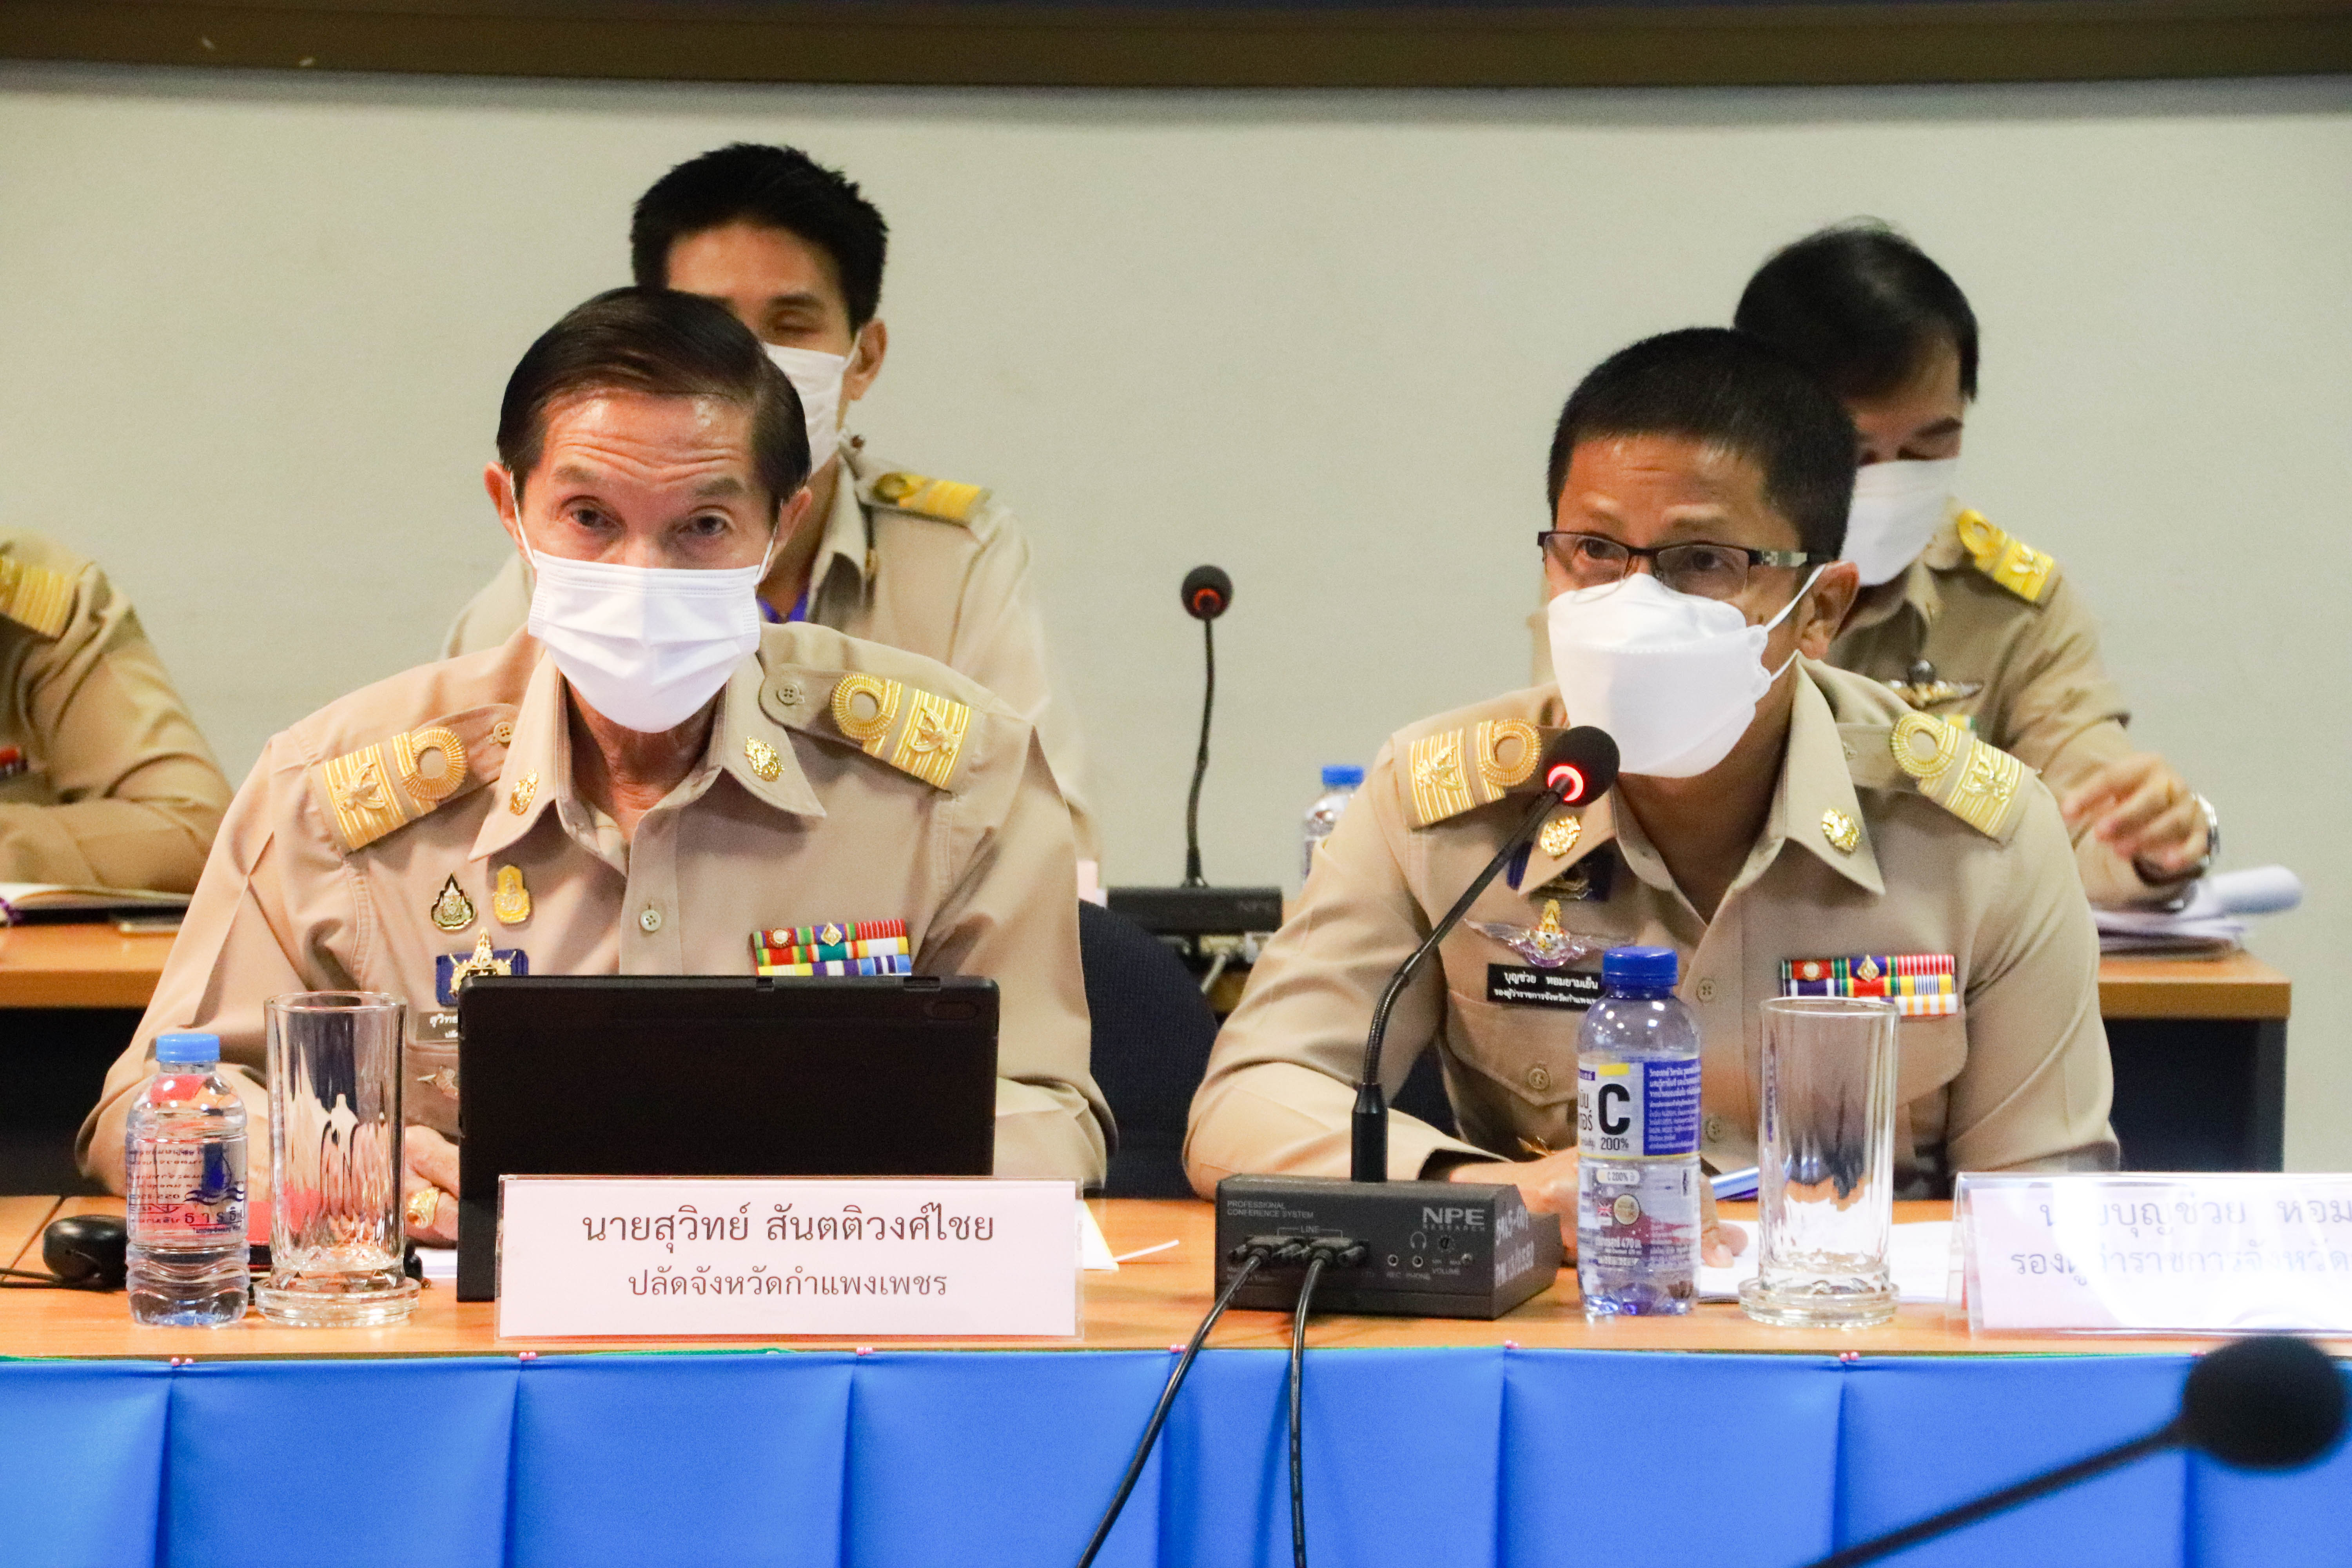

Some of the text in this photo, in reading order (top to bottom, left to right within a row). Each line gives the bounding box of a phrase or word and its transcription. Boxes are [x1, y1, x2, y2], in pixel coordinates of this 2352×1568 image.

[1504, 970, 1599, 990] บุญช่วย หอมยามเย็น
[1494, 988, 1597, 1005] รองผู้ว่าราชการจังหวัดกำแพงเพ
[429, 1013, 458, 1028] สุวิทย
[1598, 1083, 1630, 1135] C
[1601, 1137, 1629, 1150] 200%
[1227, 1200, 1286, 1210] PROFESSIONAL
[1227, 1209, 1281, 1218] CONFERENCE
[1422, 1207, 1485, 1225] NPE
[582, 1201, 994, 1254] นายสุวิทย์ สันตติวงศ์ไชย
[1300, 1225, 1320, 1234] LINE
[628, 1265, 947, 1296] ปลัดจังหวัดกำแพงเพชร
